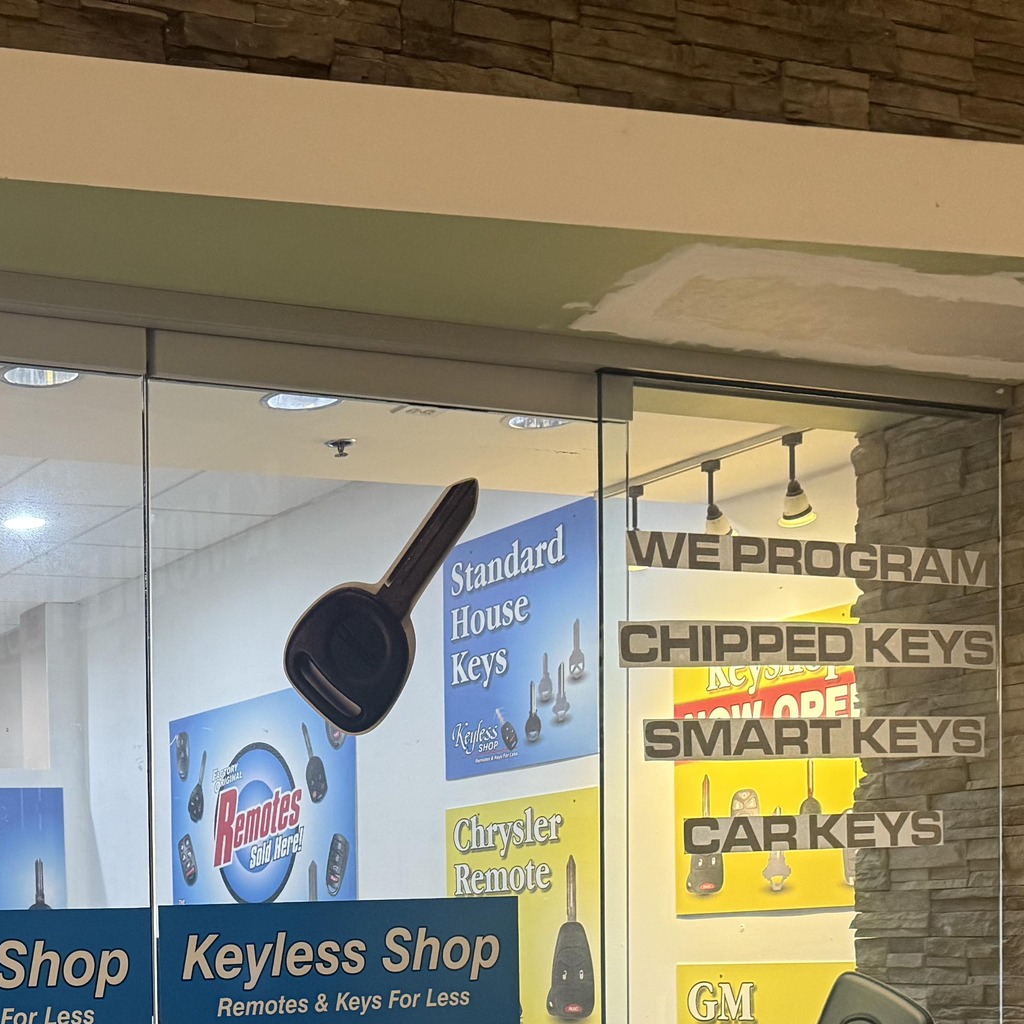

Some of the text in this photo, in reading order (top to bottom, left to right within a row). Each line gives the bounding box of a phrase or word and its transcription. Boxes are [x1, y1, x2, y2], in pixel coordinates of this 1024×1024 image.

[451, 524, 565, 596] Standard
[627, 531, 992, 586] WE PROGRAM
[451, 596, 529, 641] House
[619, 624, 995, 664] CHIPPED KEYS
[451, 648, 507, 688] Keys
[452, 719, 498, 755] Keyless
[478, 741, 499, 752] SHOP
[644, 718, 982, 757] SMART KEYS
[213, 787, 302, 868] Remotes
[249, 826, 305, 869] Sold Here!
[453, 807, 562, 856] Chrysler
[684, 811, 942, 854] CAR KEYS
[454, 859, 550, 895] Remote
[181, 926, 501, 990] Keyless Shop
[44, 1006, 95, 1024] Less
[217, 988, 470, 1017] Remotes & Keys For Less
[687, 981, 754, 1022] GM
